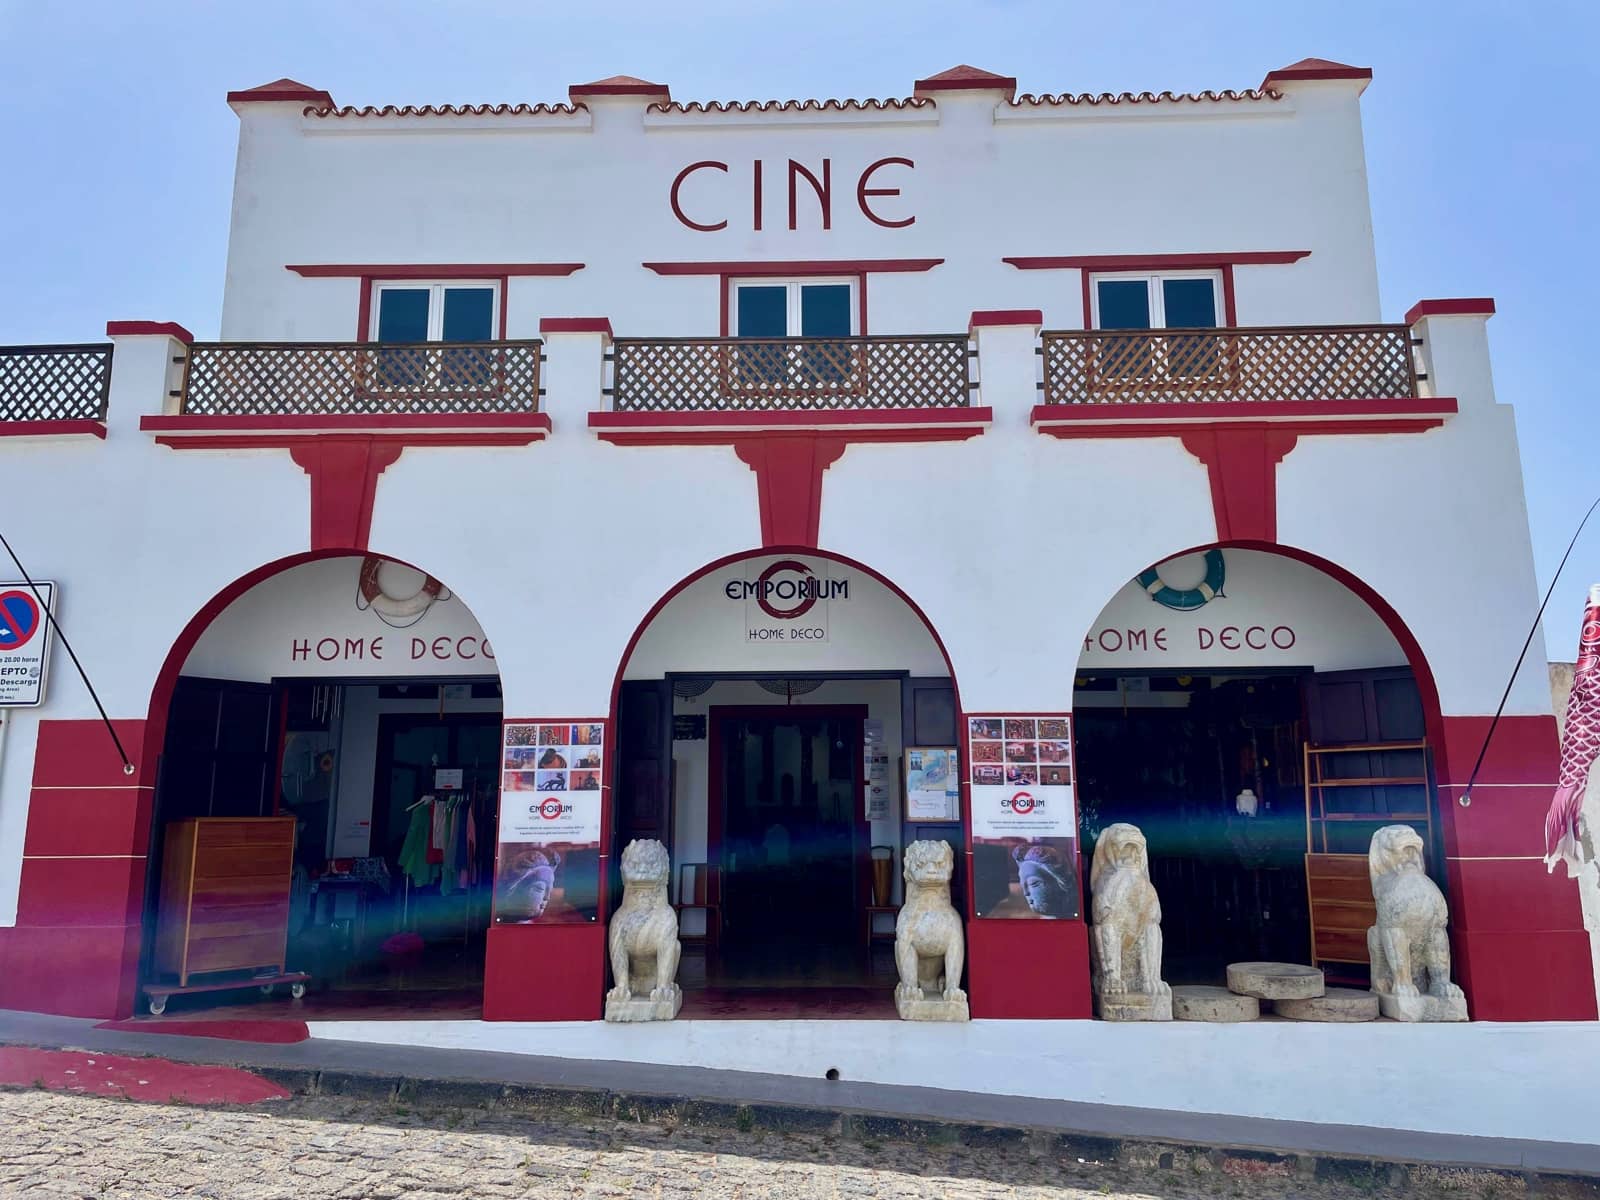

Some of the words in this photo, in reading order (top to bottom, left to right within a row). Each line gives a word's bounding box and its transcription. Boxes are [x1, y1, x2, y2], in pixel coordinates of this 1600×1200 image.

[670, 157, 915, 232] CINE
[725, 579, 849, 600] EMPORIUM
[749, 628, 784, 640] HOME
[791, 628, 824, 640] DECO
[1198, 626, 1296, 650] DECO
[292, 637, 383, 661] HOME
[529, 805, 572, 813] EMPORIUM
[1000, 800, 1045, 808] EMPORIUM
